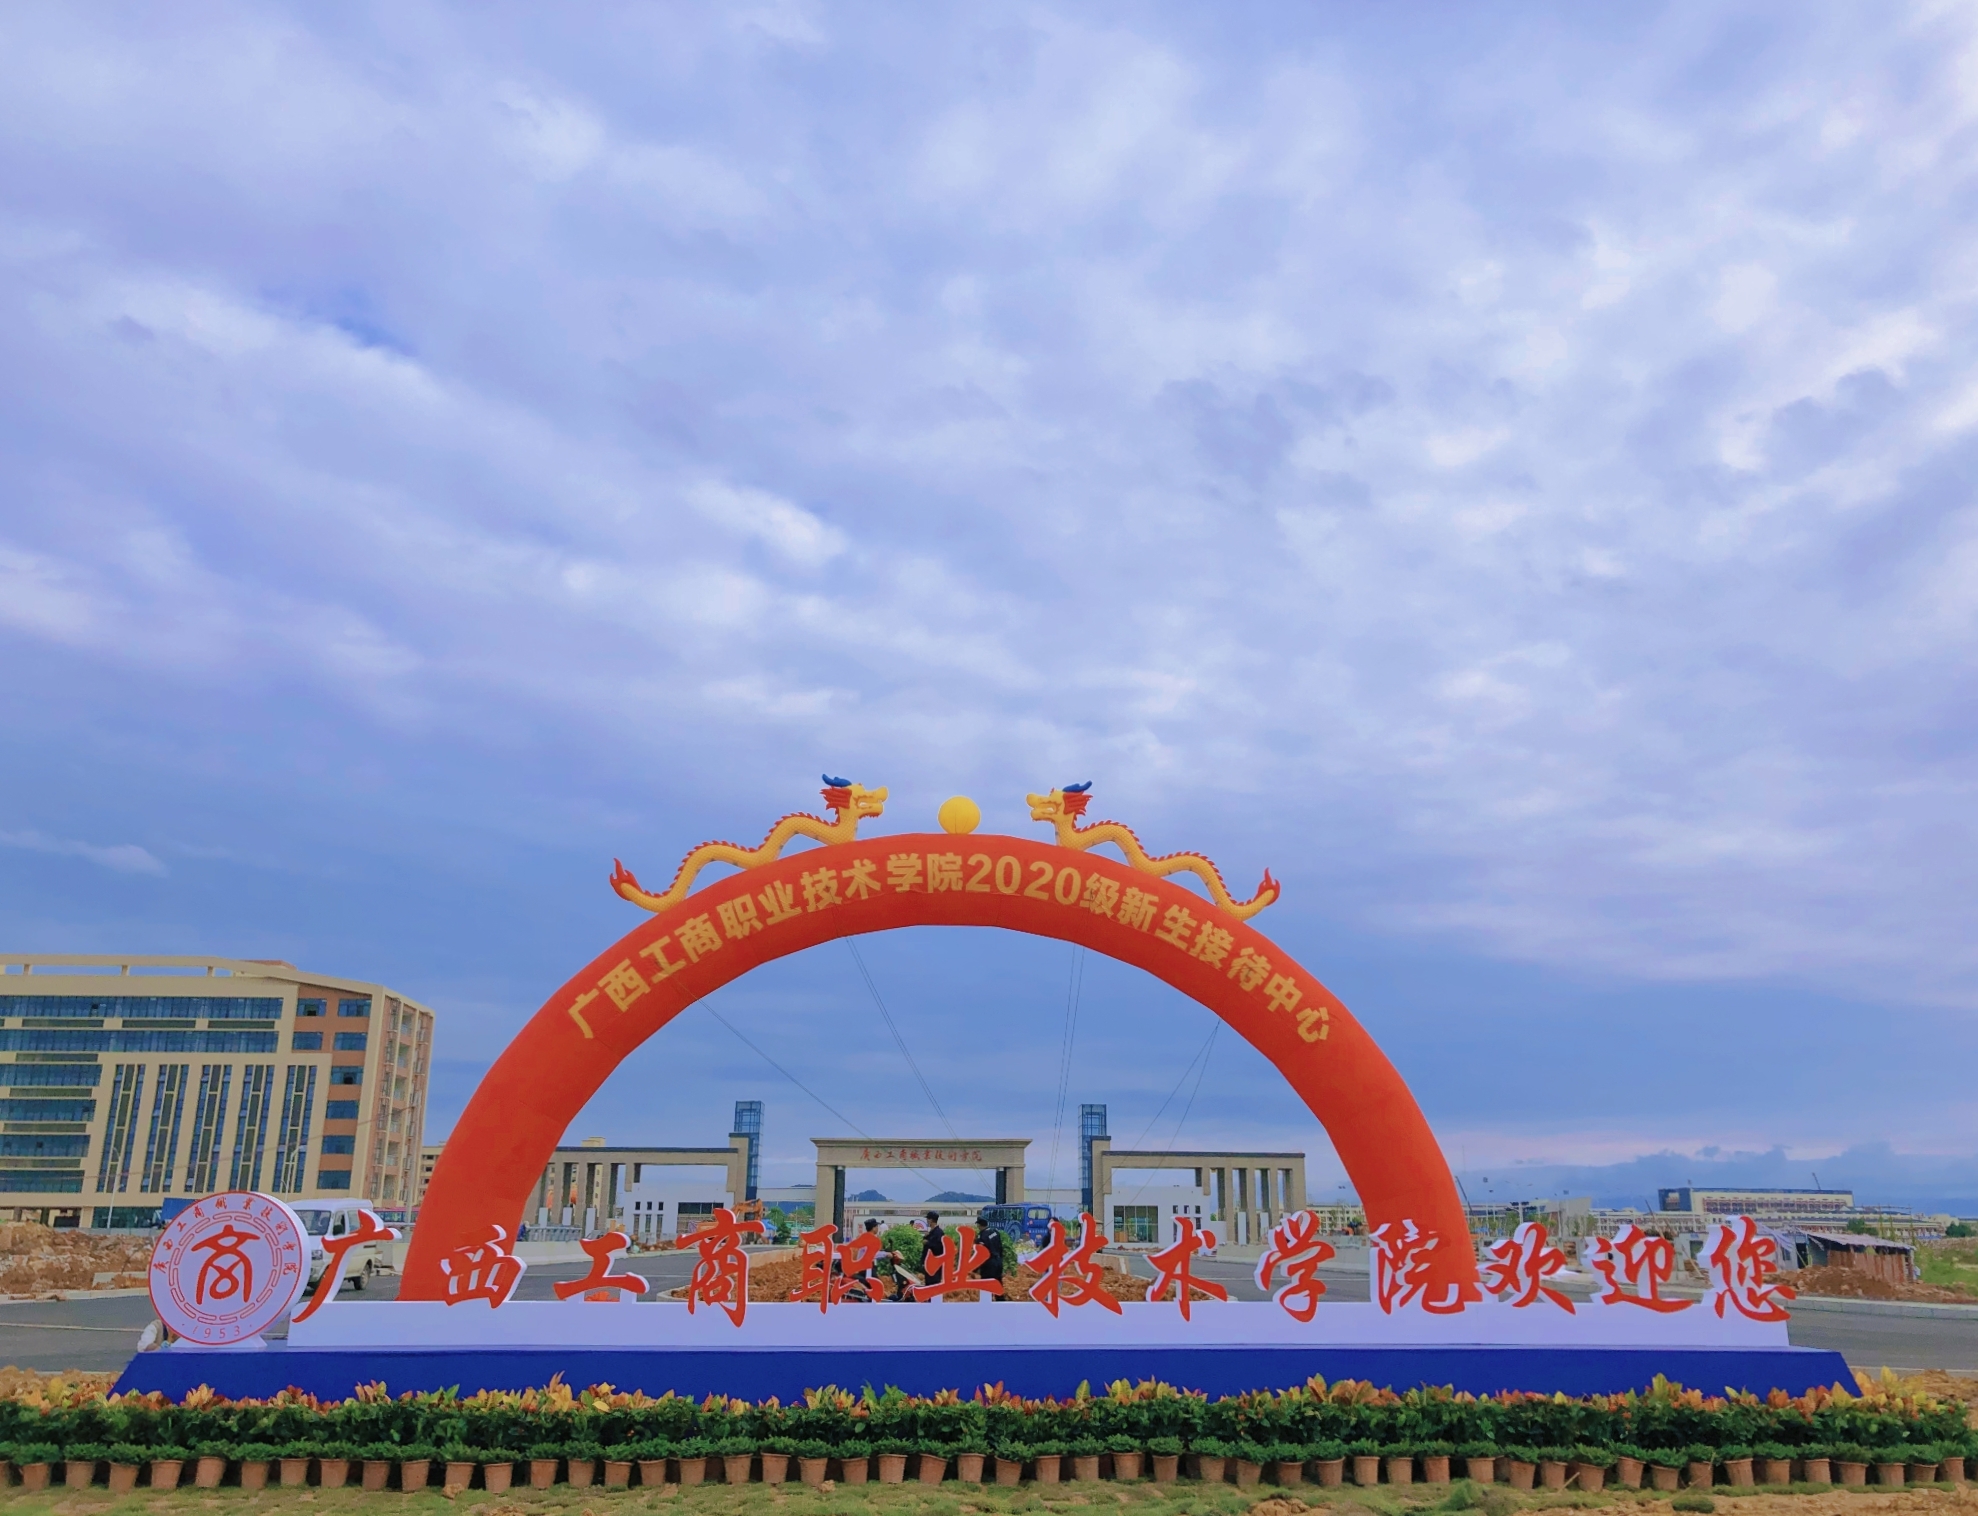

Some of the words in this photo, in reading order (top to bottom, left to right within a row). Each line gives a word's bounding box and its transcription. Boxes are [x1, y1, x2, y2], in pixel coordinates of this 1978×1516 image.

[567, 852, 1331, 1043] 广西工商职业技术学院2020级新生接待中心
[287, 1210, 1797, 1326] 广西工商职业技术学院欢迎您
[191, 1325, 241, 1339] 1953
